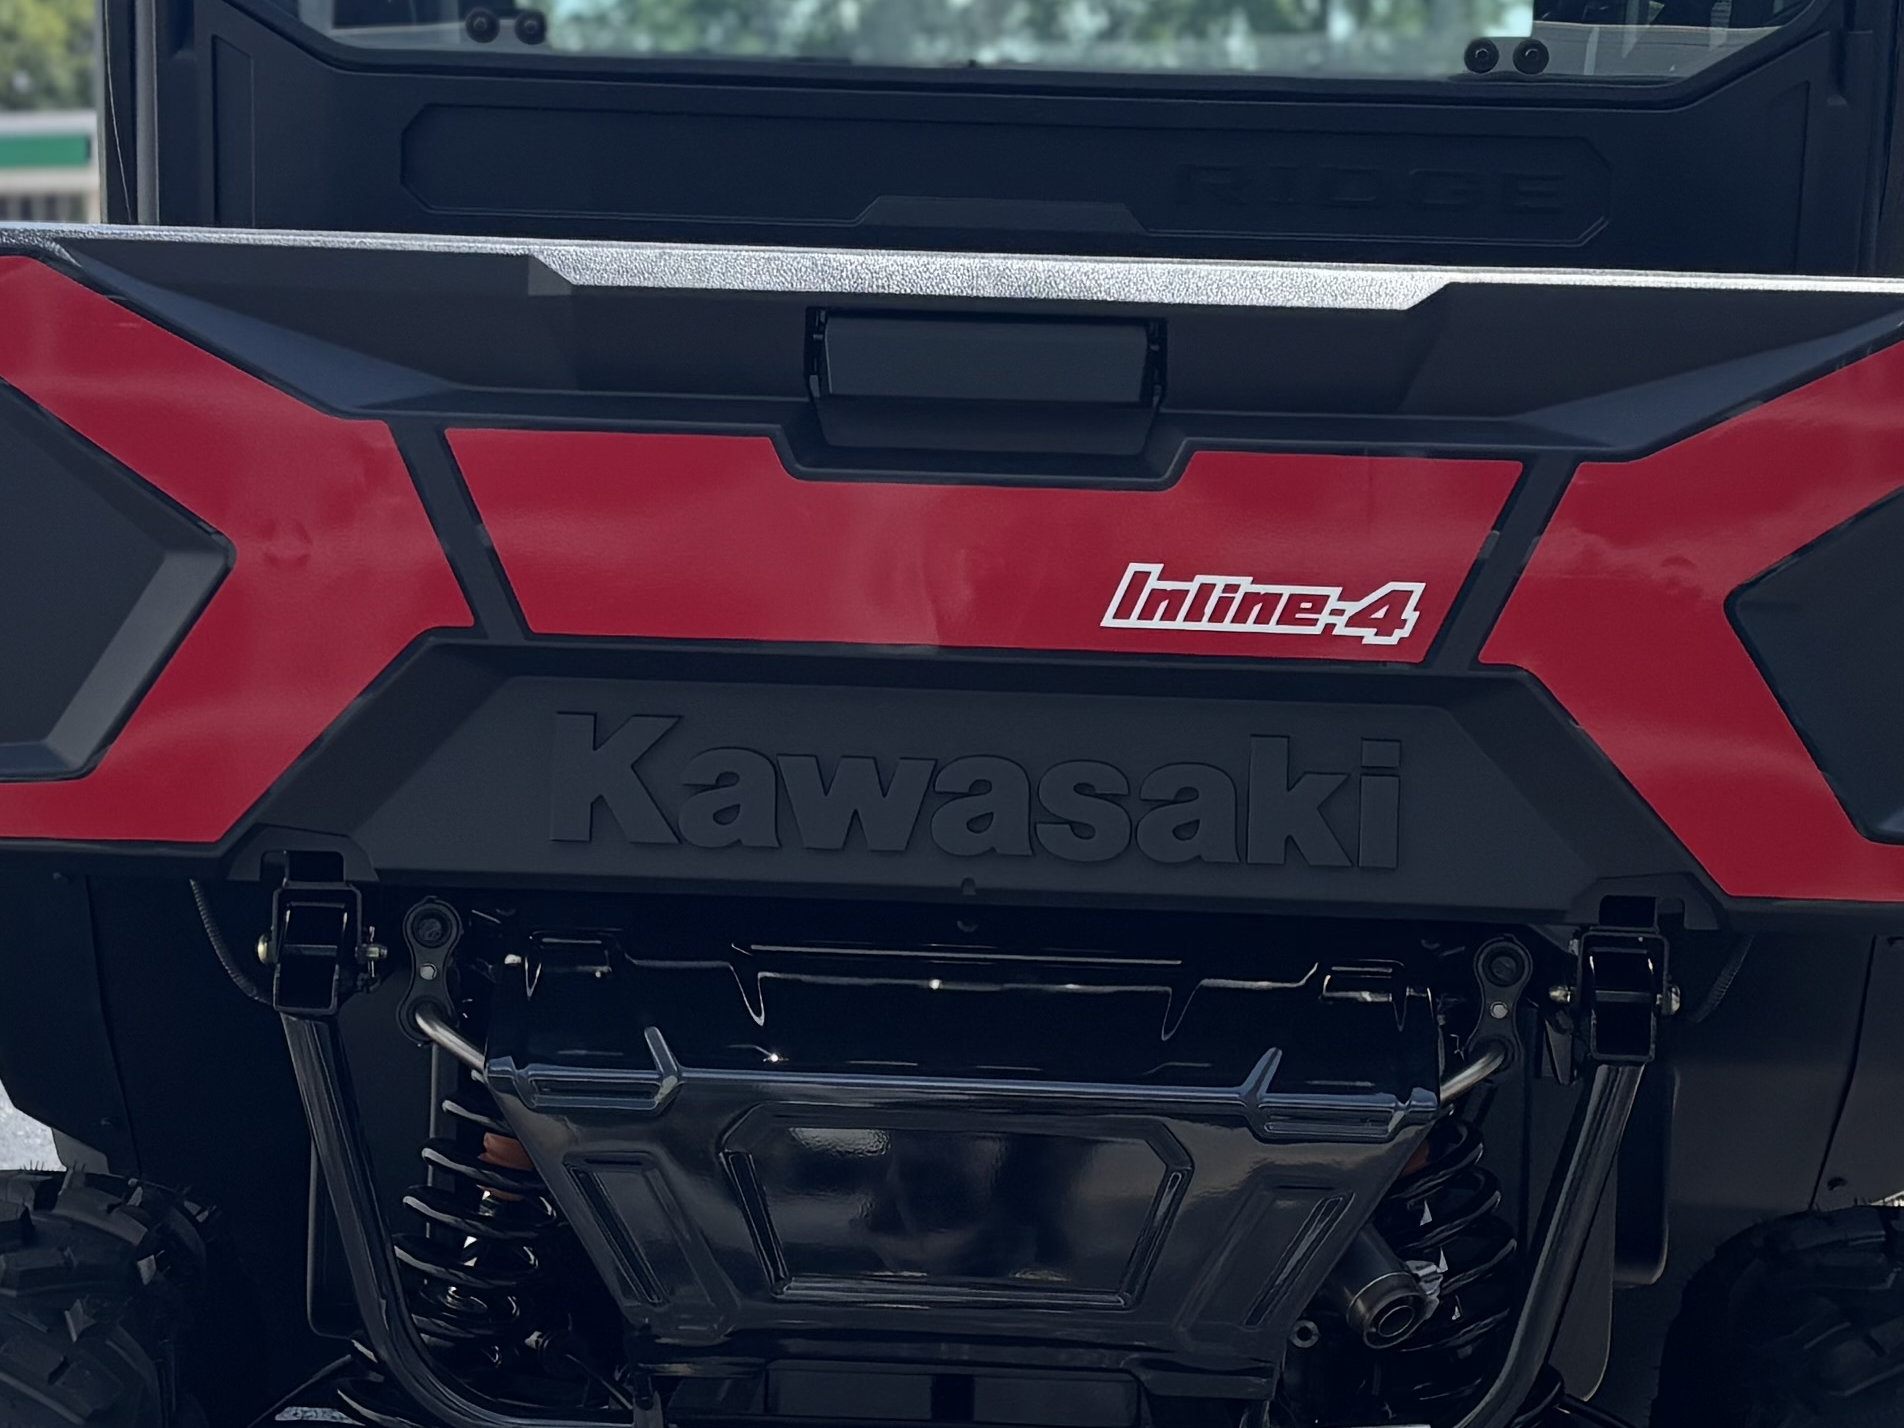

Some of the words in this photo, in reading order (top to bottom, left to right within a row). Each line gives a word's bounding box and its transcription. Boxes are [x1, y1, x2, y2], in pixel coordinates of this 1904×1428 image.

[1175, 163, 1566, 214] RIDGE
[1100, 563, 1427, 646] Inline-4
[549, 710, 1402, 870] Kawasaki
